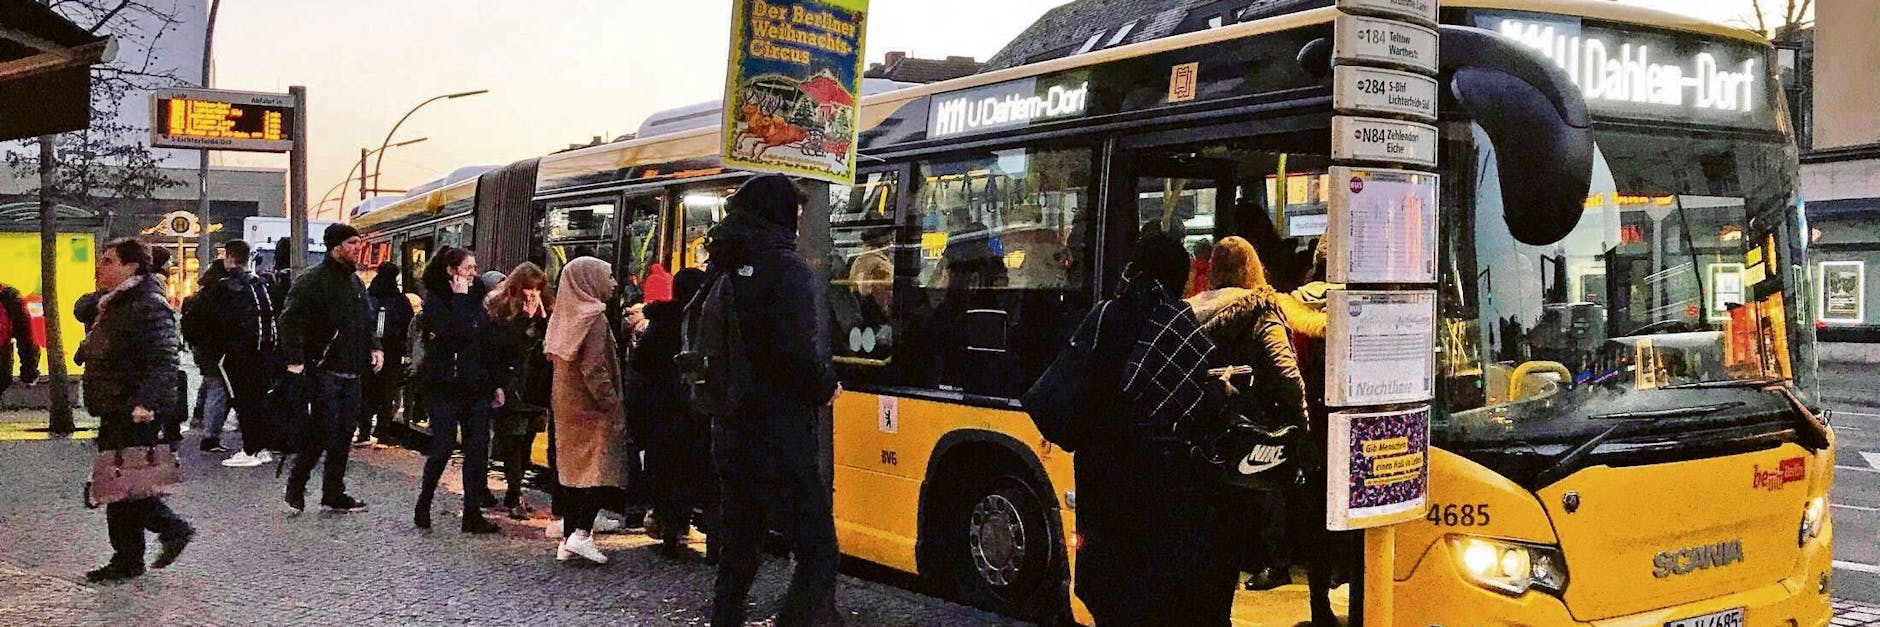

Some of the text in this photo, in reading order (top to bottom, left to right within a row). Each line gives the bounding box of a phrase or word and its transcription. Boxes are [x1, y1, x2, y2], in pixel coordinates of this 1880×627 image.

[752, 0, 855, 37] Der Berliner
[752, 19, 852, 55] Weihnachts-
[1366, 29, 1386, 44] 184
[750, 39, 810, 64] Circus
[1365, 79, 1407, 94] 284 S-Bhf
[1585, 37, 1754, 112] Dahlem-Dorf
[936, 80, 1089, 135] M11 U Dahlem-Dorf
[1362, 128, 1385, 143] N84
[1350, 181, 1363, 189] BUS
[881, 450, 897, 466] BVG
[1248, 443, 1285, 463] NIKE
[1426, 503, 1490, 527] 4685
[1653, 539, 1744, 578] SCANIA
